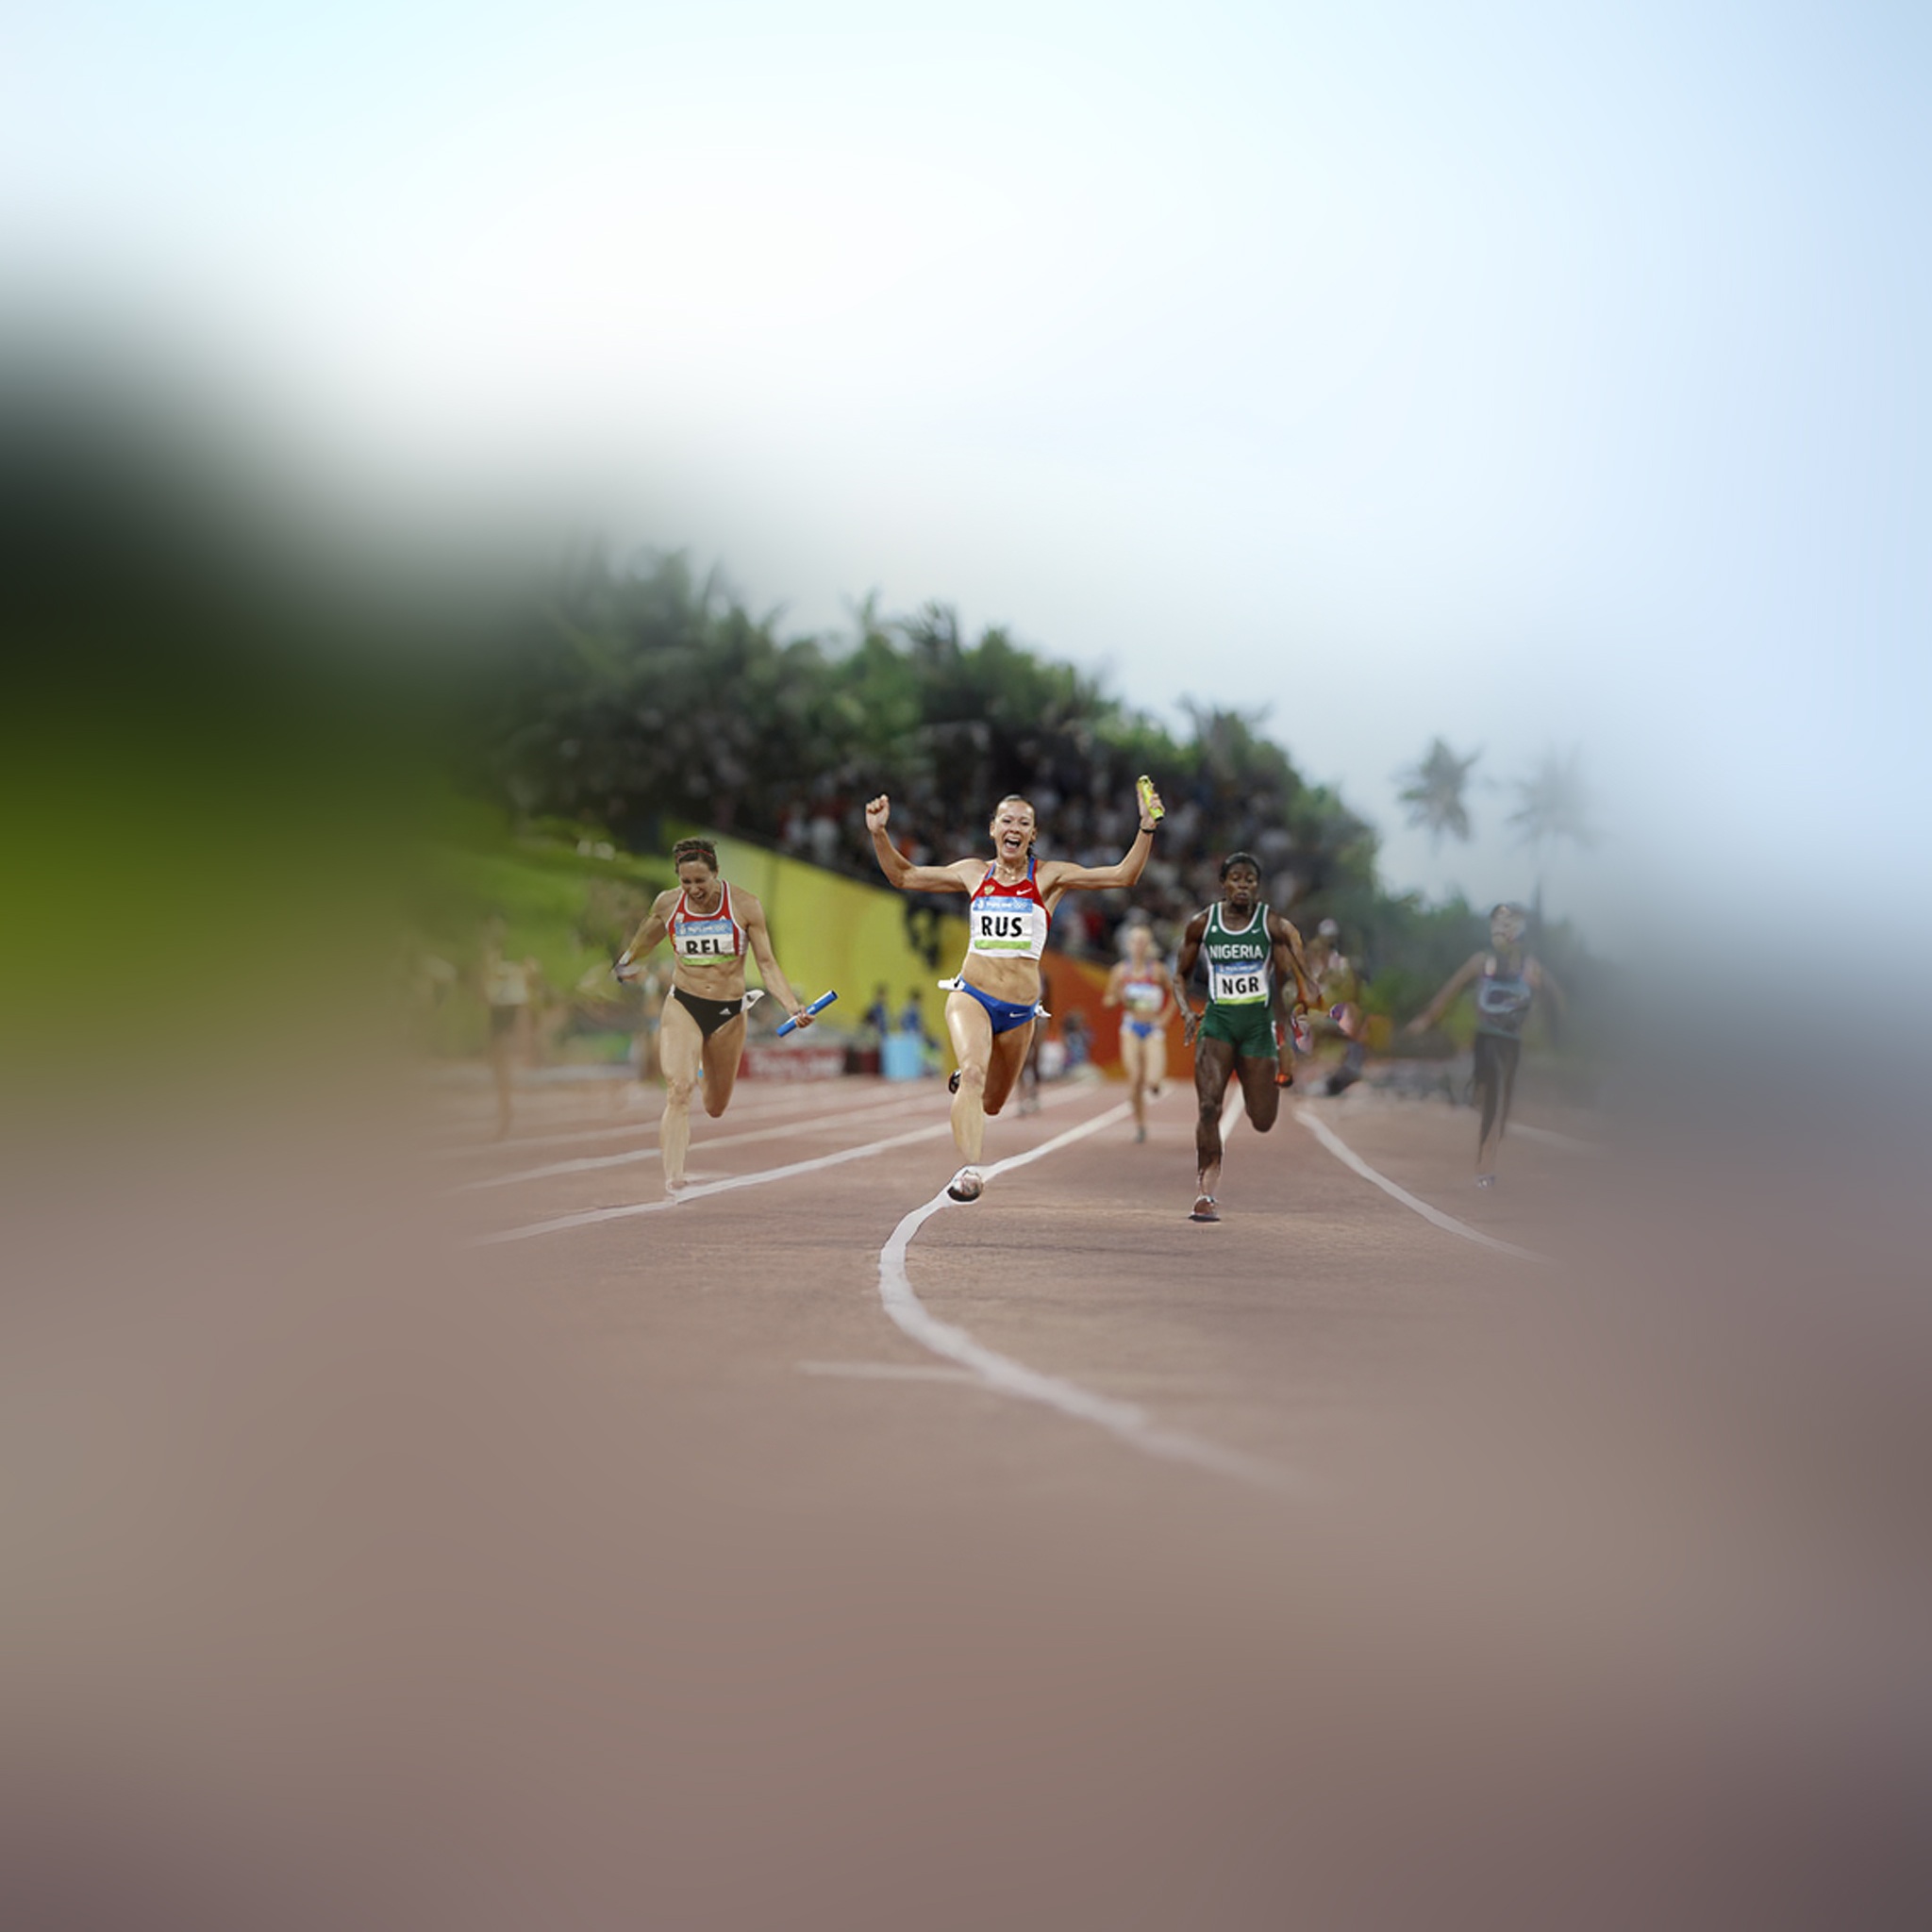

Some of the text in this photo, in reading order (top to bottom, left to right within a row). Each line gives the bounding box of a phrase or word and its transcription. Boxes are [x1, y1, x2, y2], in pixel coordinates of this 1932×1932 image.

[981, 916, 1022, 937] RUS
[1209, 944, 1263, 959] NIGERIA
[1222, 976, 1259, 994] NGR
